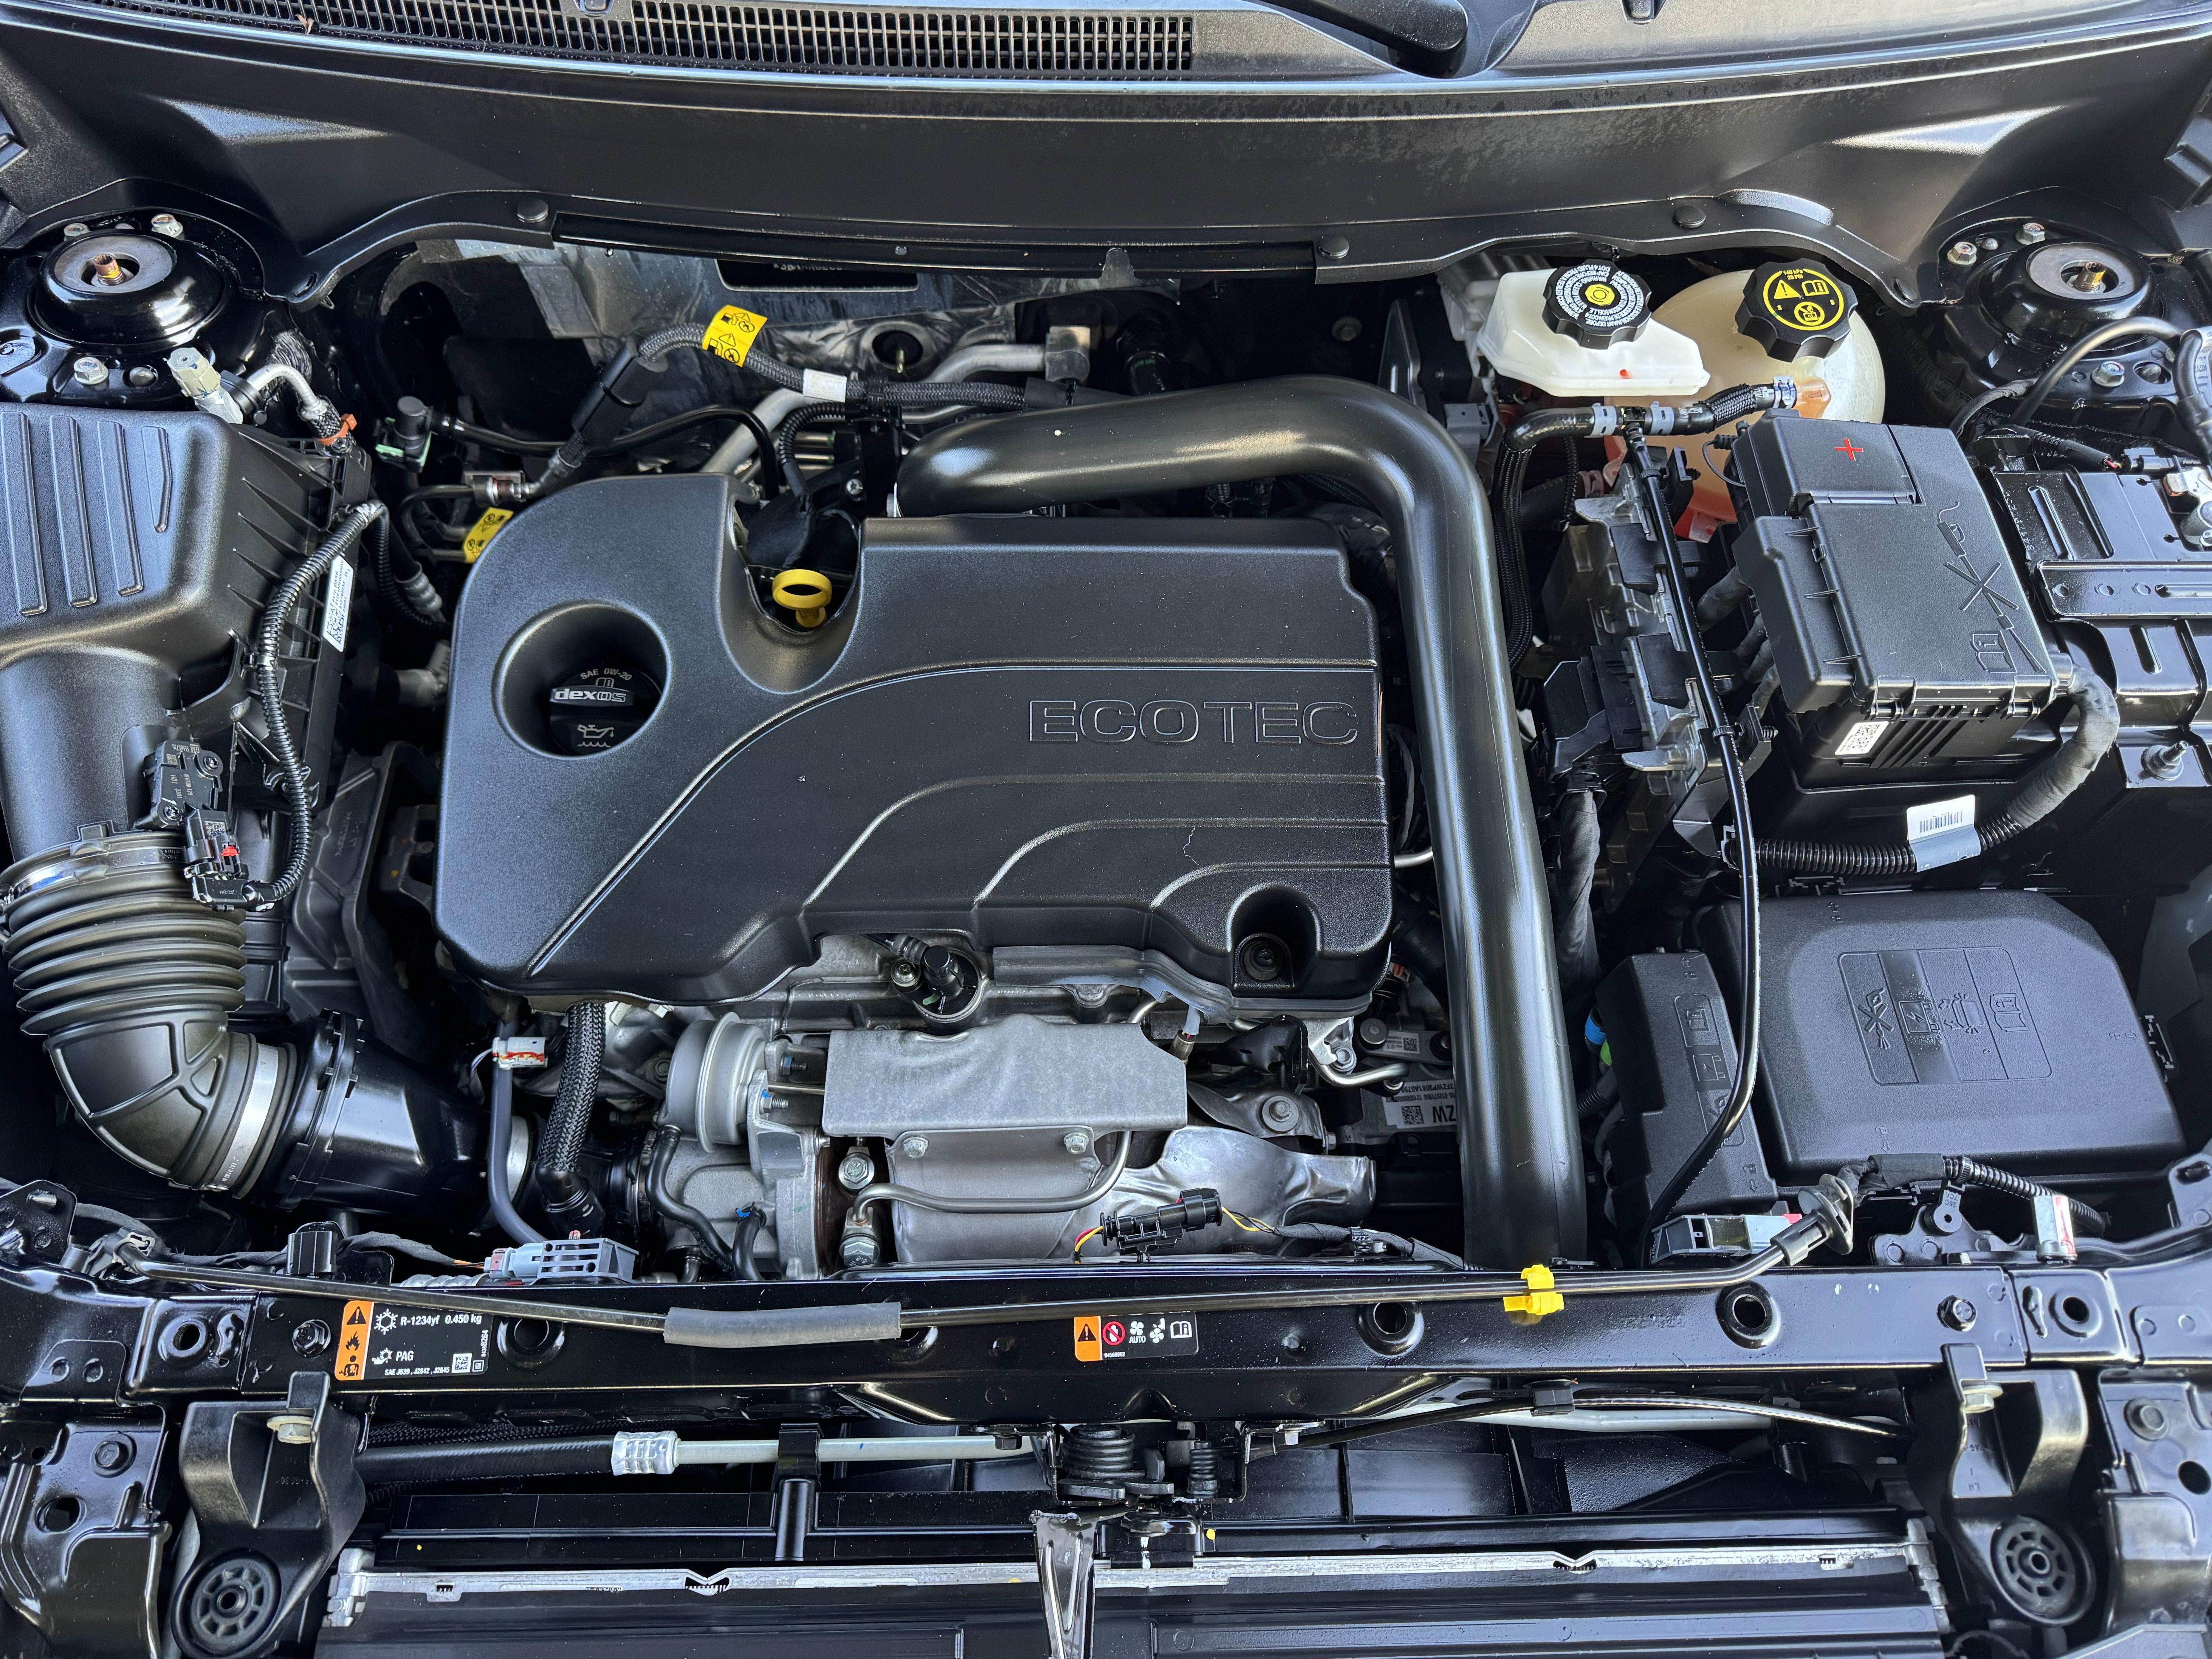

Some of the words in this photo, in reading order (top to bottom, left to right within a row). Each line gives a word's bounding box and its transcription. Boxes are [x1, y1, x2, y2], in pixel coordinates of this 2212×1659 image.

[1563, 268, 1580, 280] FROM
[1575, 270, 1596, 280] BEFORE
[1556, 279, 1568, 295] SEALED
[1572, 282, 1582, 295] CLEAN
[1565, 295, 1576, 304] USE
[1573, 295, 1587, 310] FILLER
[1570, 302, 1584, 314] ONLY
[581, 668, 599, 680] SAE
[604, 668, 632, 681] 0W-20
[554, 688, 627, 703] dexos
[1029, 699, 1358, 745] ECOTEC
[1432, 1105, 1456, 1123] ZW
[400, 1315, 440, 1327] R-1234yf
[445, 1314, 469, 1324] 0.450
[470, 1314, 483, 1325] kg
[1129, 1336, 1146, 1344] AUTO
[396, 1350, 414, 1362] PAG
